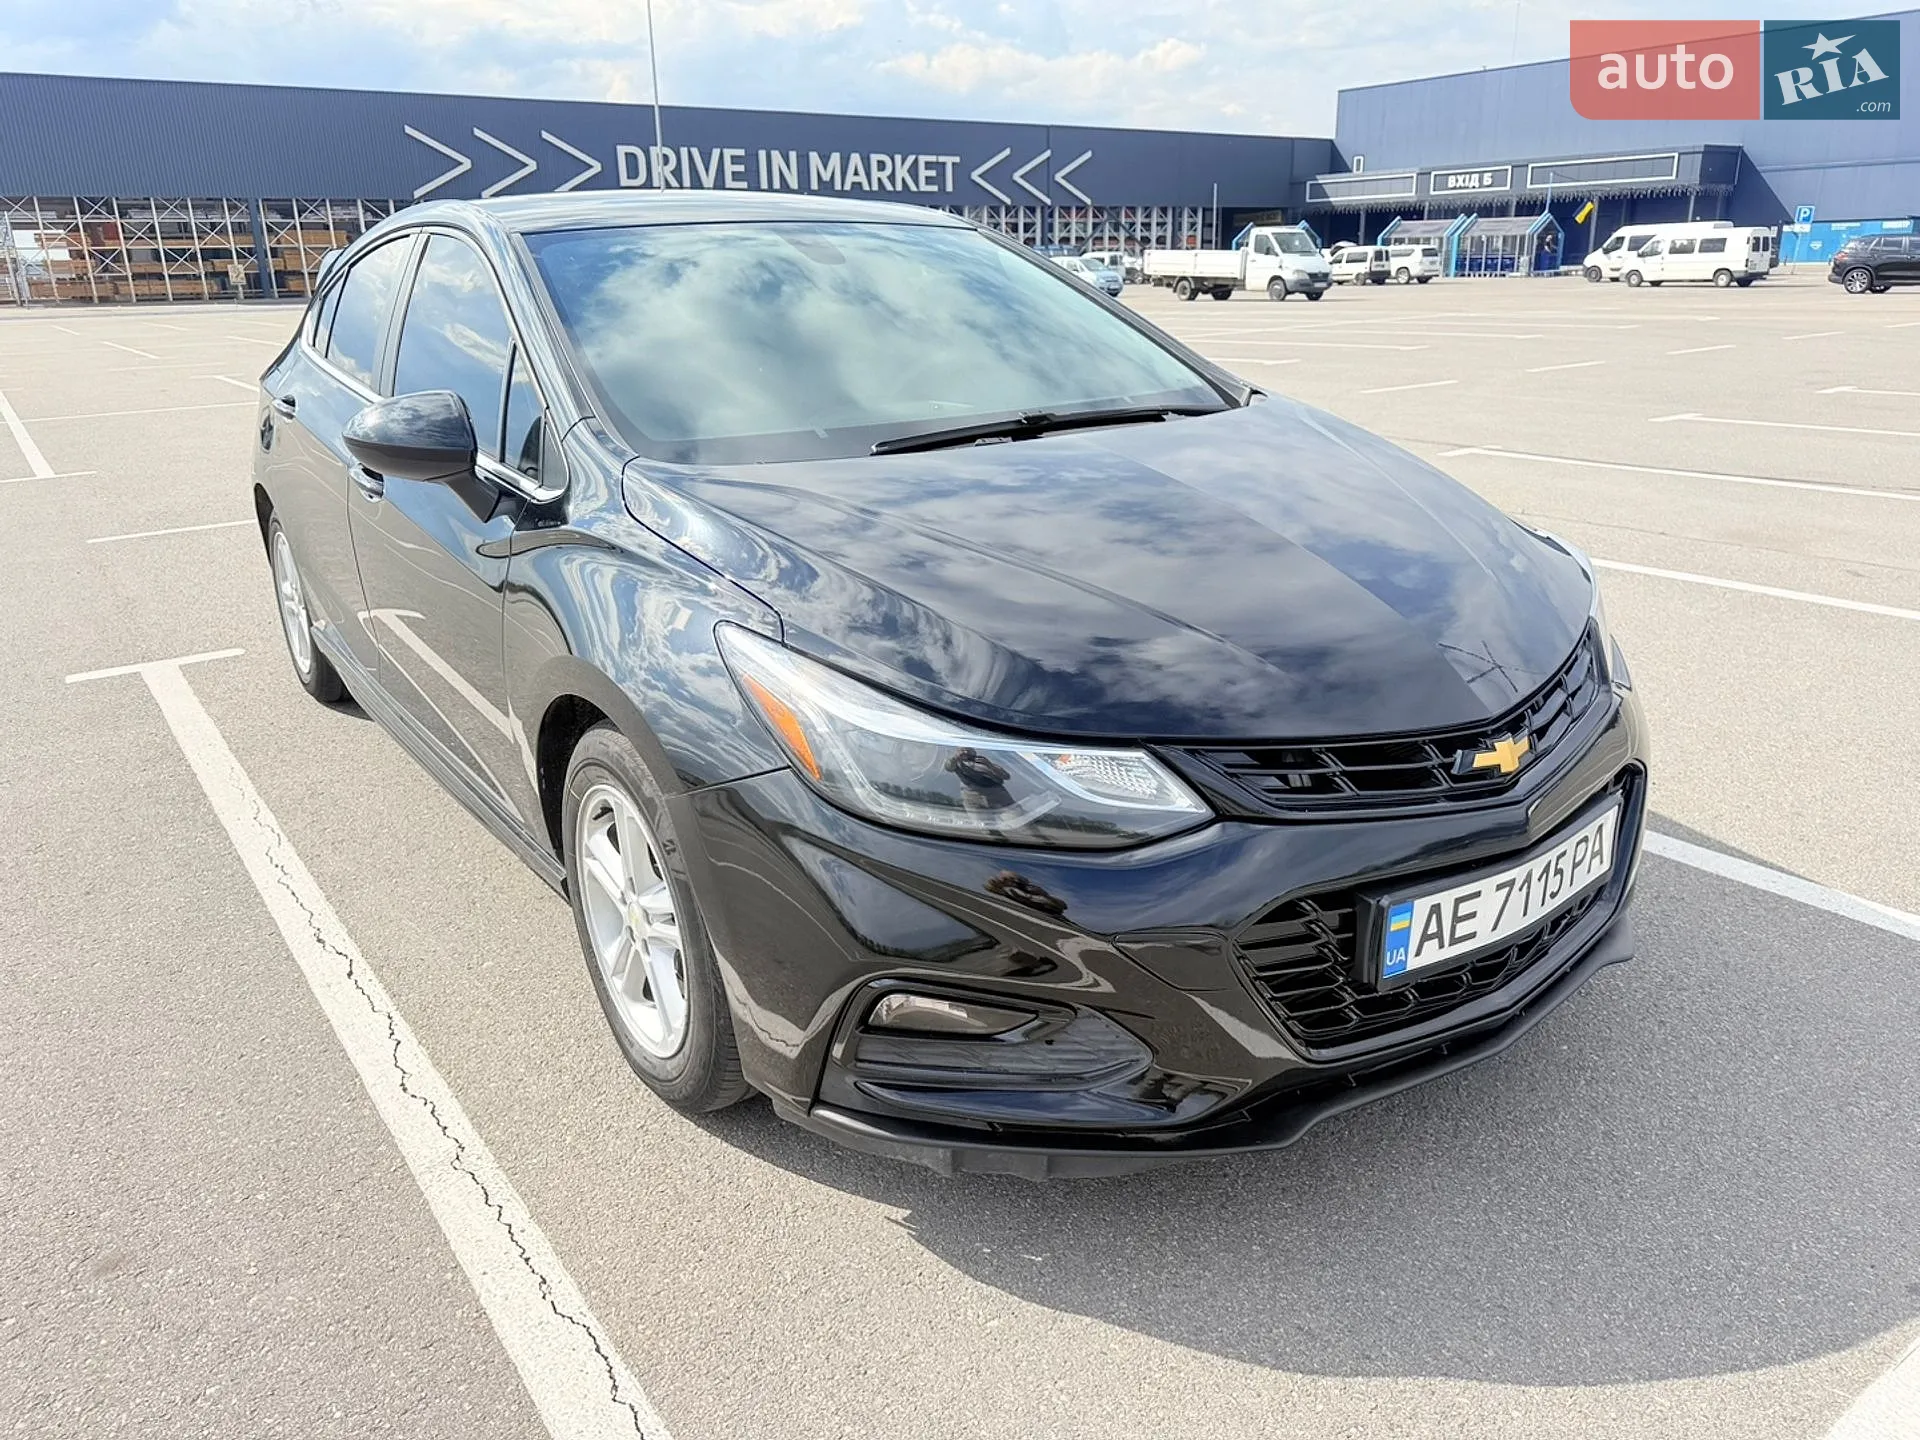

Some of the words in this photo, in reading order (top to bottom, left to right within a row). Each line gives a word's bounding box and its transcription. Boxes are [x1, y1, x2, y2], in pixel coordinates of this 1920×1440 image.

[616, 144, 748, 189] DRIVE
[757, 149, 799, 190] IN
[808, 150, 960, 193] MARKET
[1447, 173, 1480, 188] ВХІД
[1800, 207, 1811, 220] P
[1414, 890, 1482, 958] AE
[1386, 947, 1406, 966] UA
